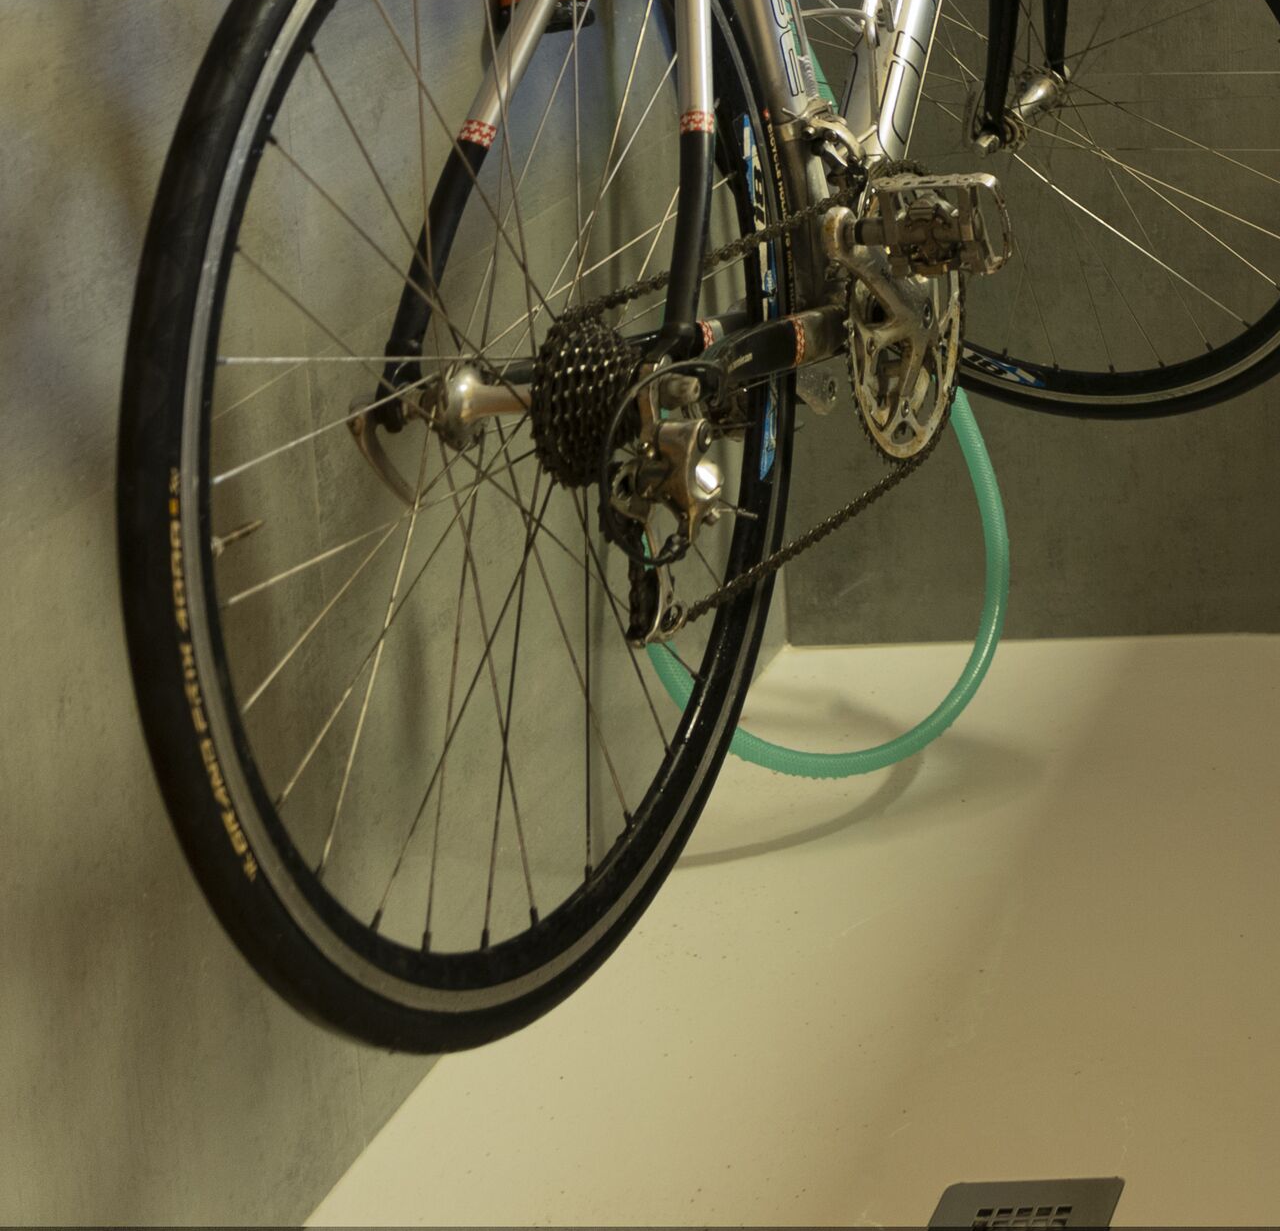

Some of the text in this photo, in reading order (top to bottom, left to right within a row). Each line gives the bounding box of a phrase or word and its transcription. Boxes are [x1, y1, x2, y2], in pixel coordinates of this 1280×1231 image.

[767, 123, 781, 179] BICYCLE
[180, 643, 208, 732] PRIX
[202, 738, 248, 856] GRAND
